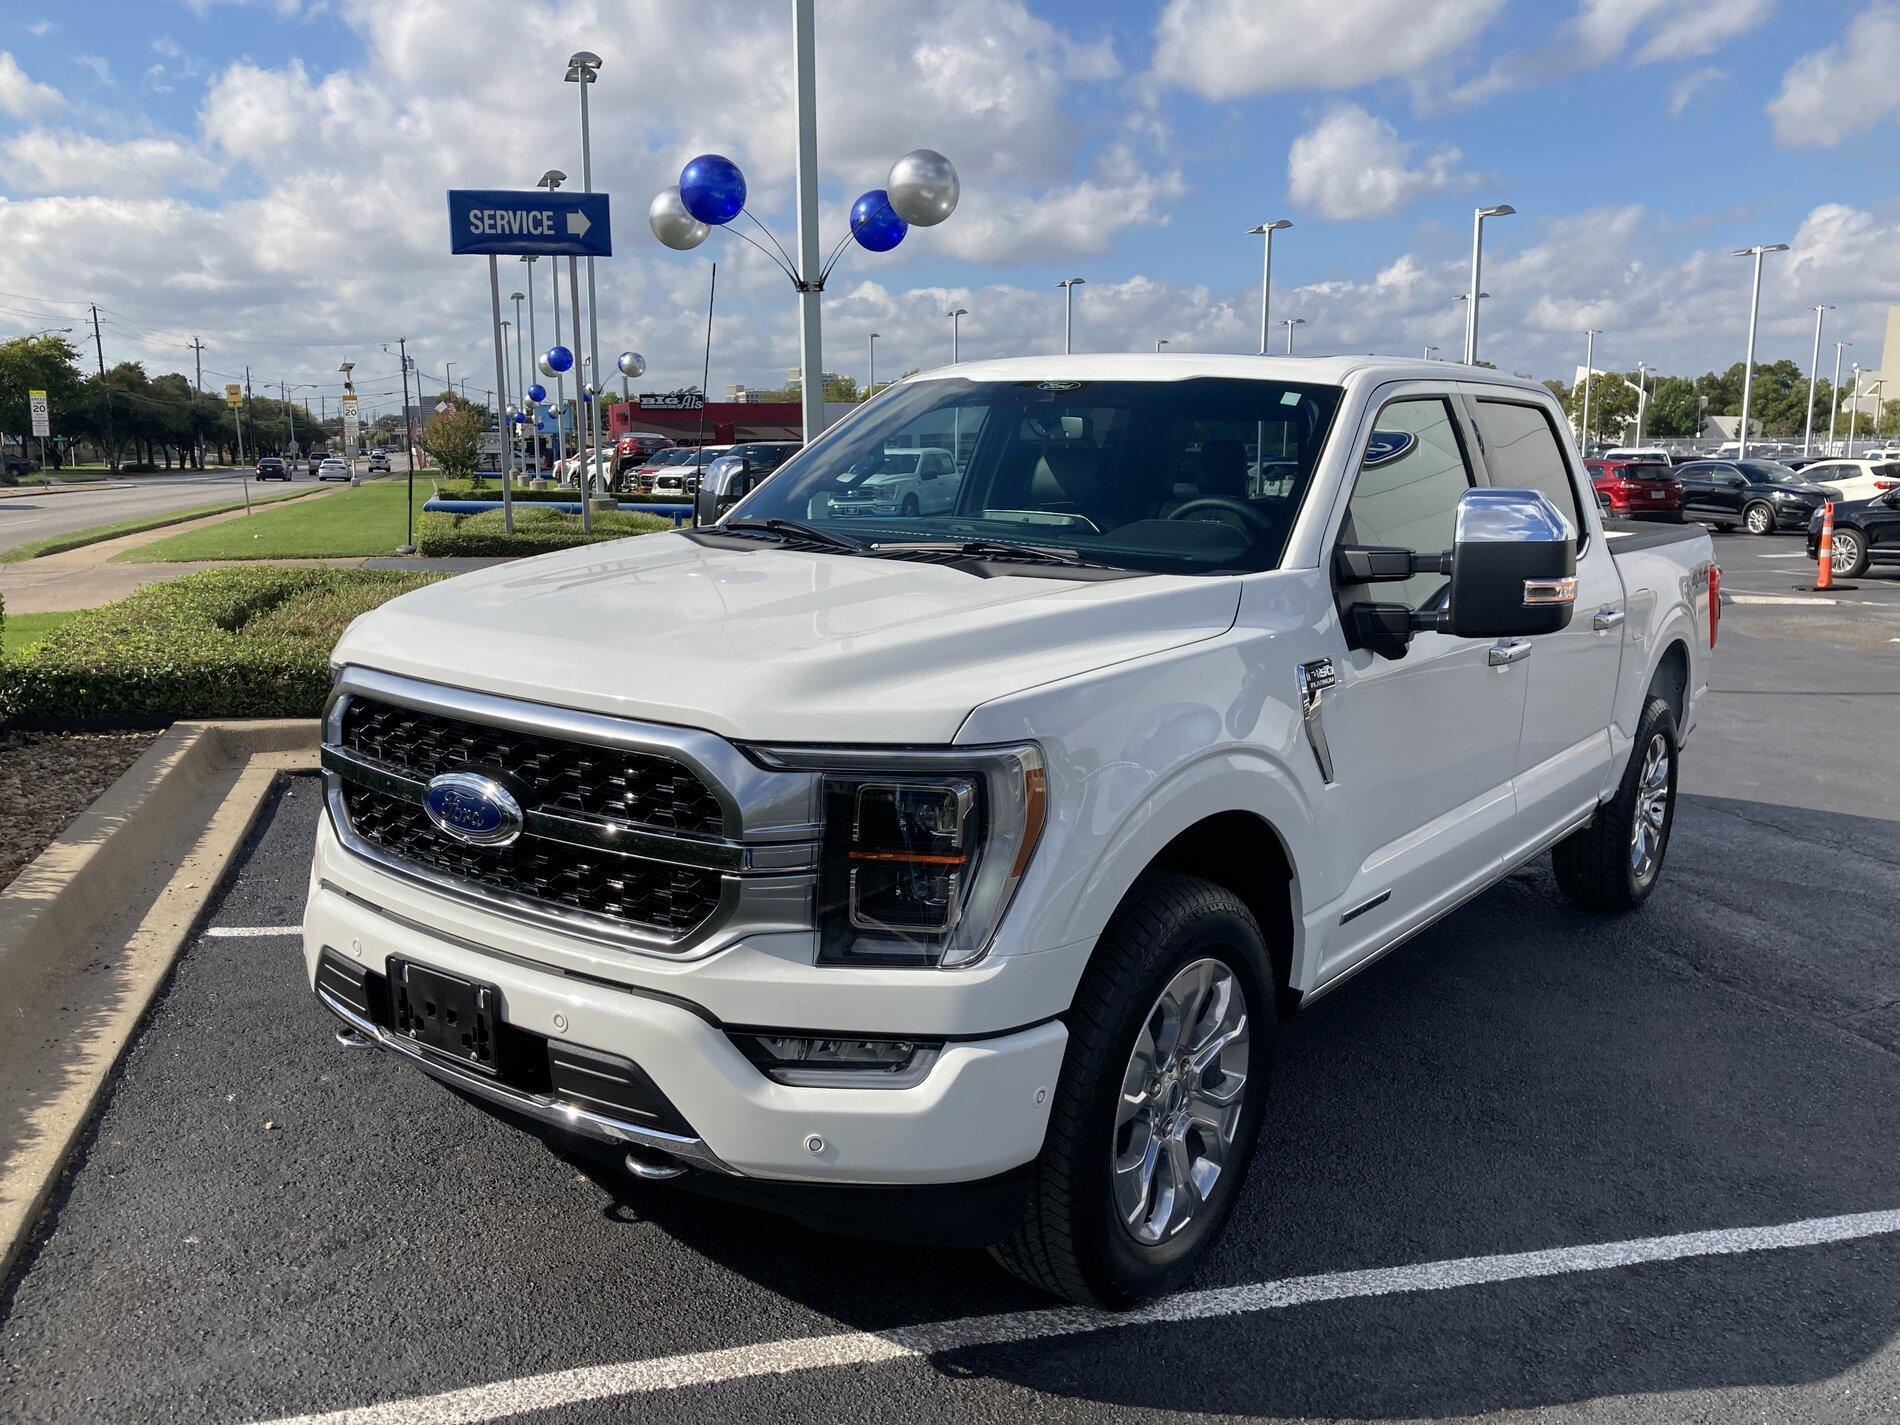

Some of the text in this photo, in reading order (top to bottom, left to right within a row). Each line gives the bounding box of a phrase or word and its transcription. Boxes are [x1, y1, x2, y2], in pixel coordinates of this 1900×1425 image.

[469, 209, 555, 235] SERVICE
[640, 396, 680, 405] BIG
[33, 405, 46, 413] 20
[345, 408, 357, 417] 20
[1310, 676, 1335, 689] PLATINUM
[441, 790, 486, 828] Ford
